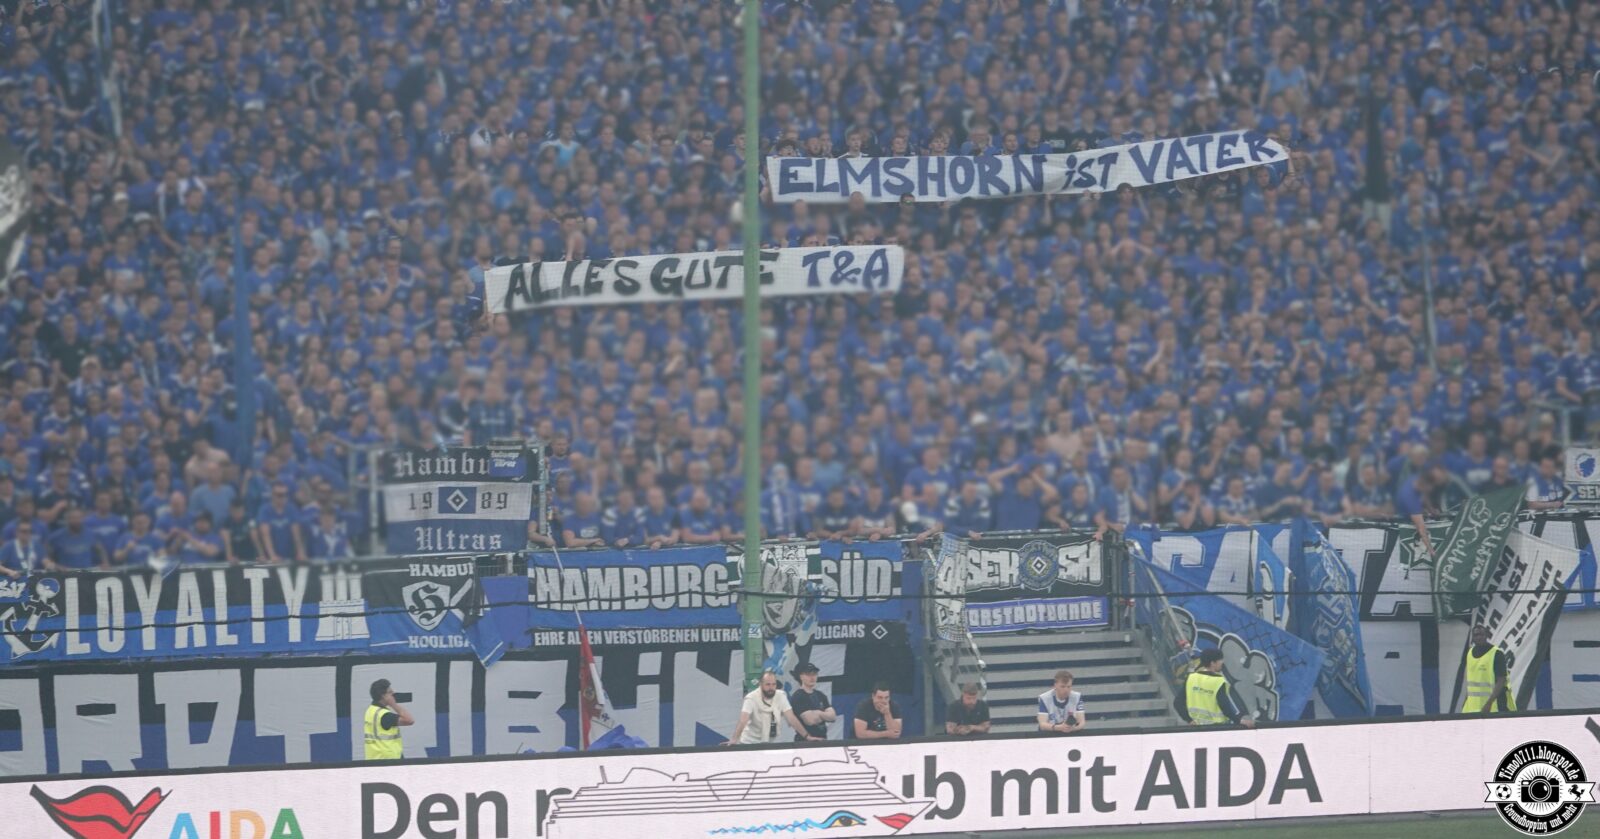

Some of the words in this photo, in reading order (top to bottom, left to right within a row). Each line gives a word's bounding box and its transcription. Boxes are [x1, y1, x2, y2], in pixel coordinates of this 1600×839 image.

[779, 155, 1047, 197] ELMSHORN
[1128, 130, 1279, 184] VATER
[504, 259, 641, 309] ALLES
[650, 251, 780, 297] GUTE
[802, 249, 889, 289] T&A
[393, 451, 491, 477] Hambu
[65, 566, 308, 655] LOYALTY
[536, 563, 730, 611] HAMBURG
[820, 552, 893, 603] SÜD
[534, 631, 565, 646] EHRE
[567, 630, 602, 645] ALEN
[604, 628, 699, 645] VERSTORBENEN
[361, 782, 509, 839] Den
[991, 749, 1117, 817] mit
[1134, 743, 1323, 812] AIDA
